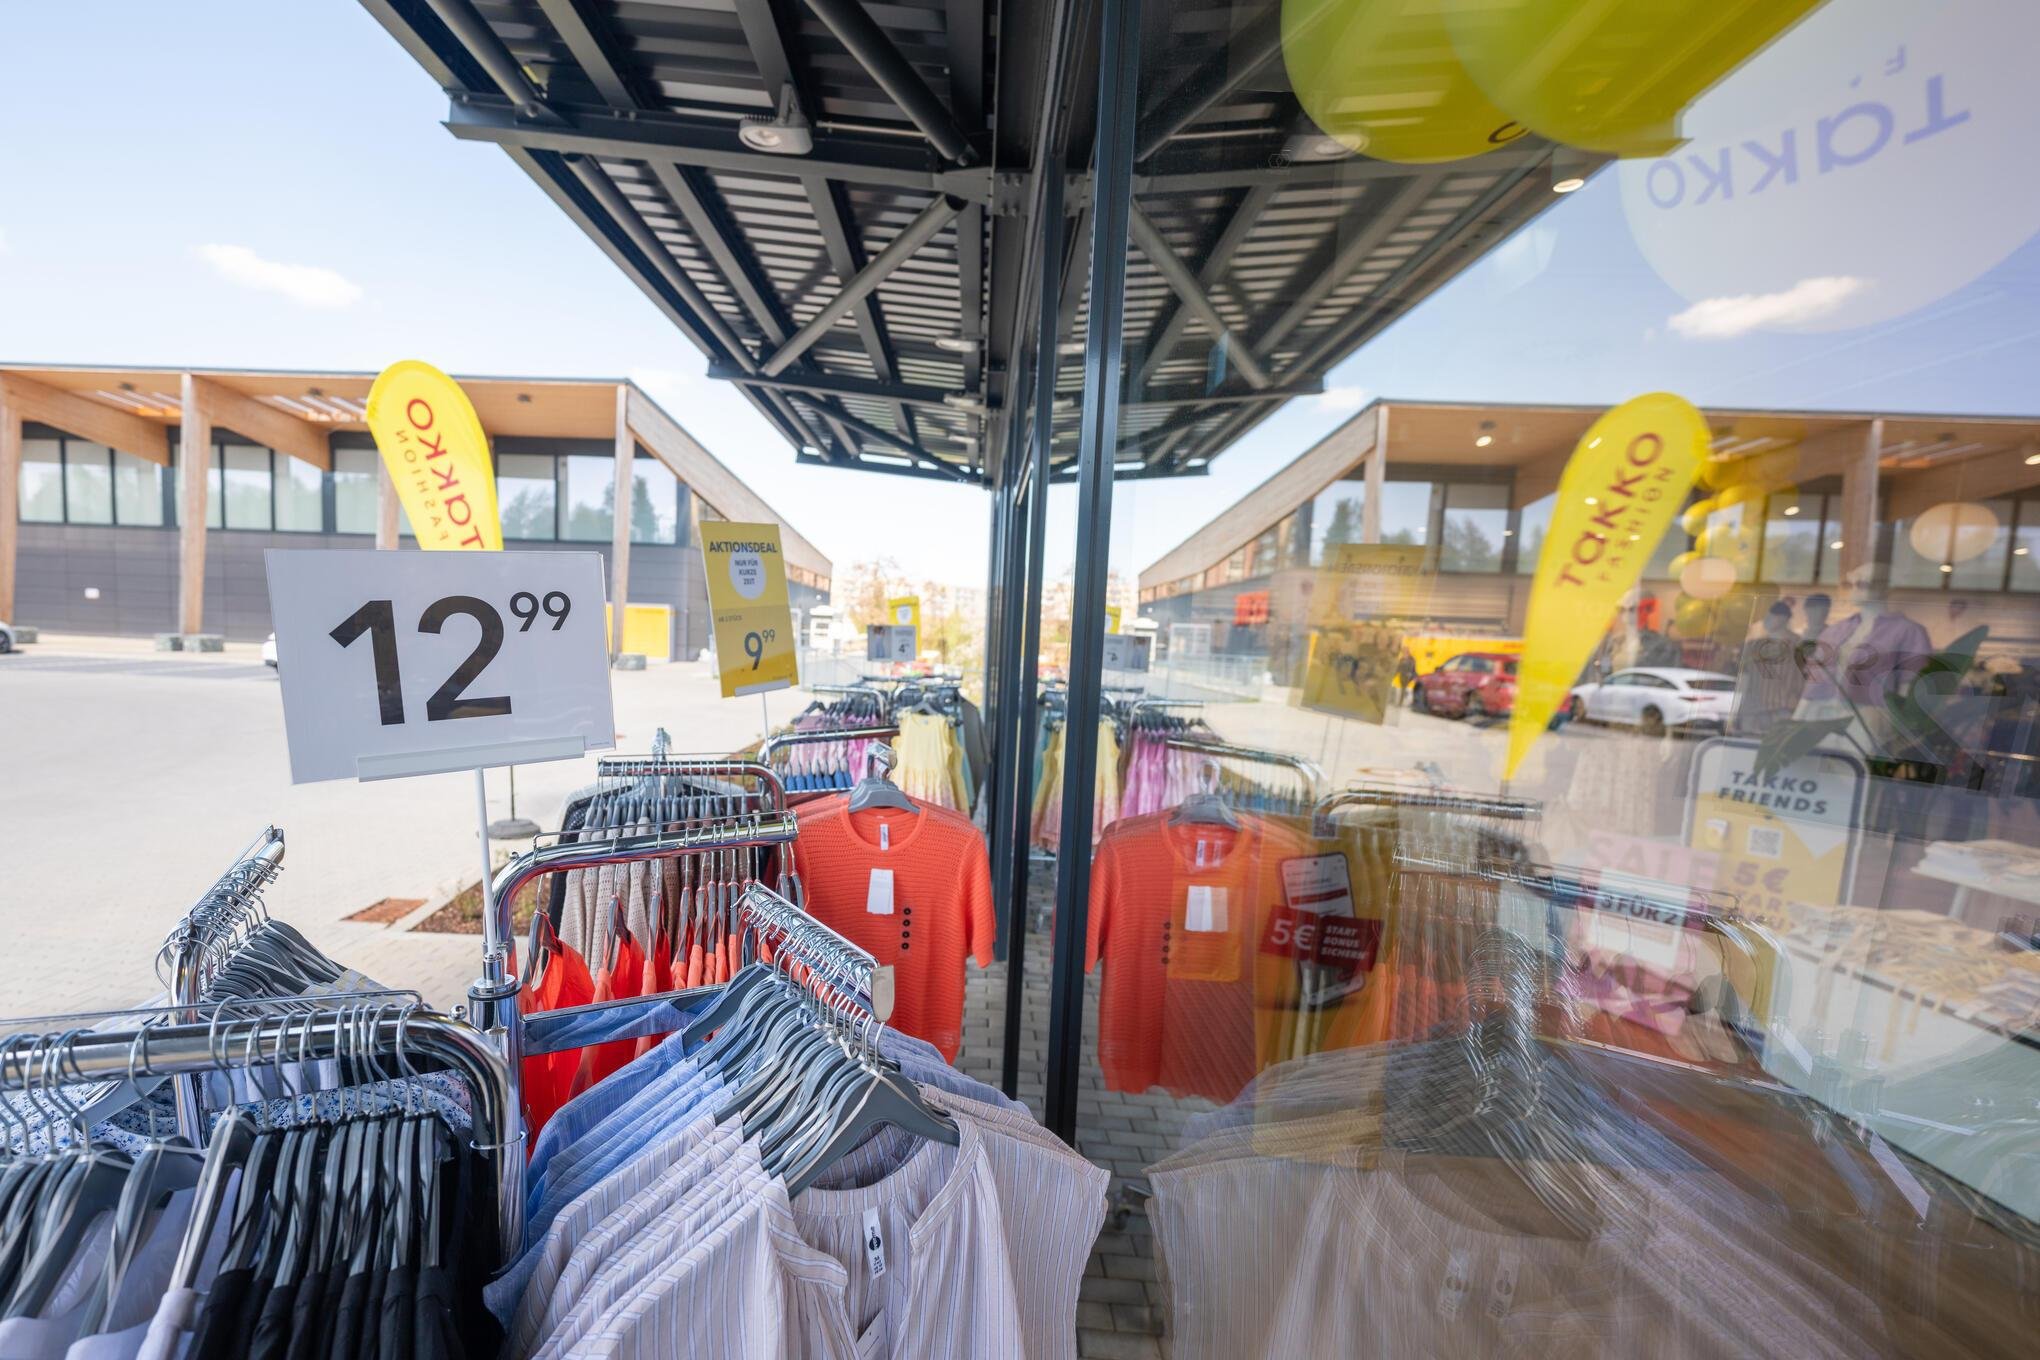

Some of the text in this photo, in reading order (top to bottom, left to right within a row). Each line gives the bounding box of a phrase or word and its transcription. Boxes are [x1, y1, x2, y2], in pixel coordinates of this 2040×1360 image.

[709, 541, 778, 553] AKTIONSDEAL
[1732, 770, 1818, 795] TAKKO
[1718, 786, 1828, 815] FRIENDS
[1325, 924, 1358, 937] START
[1322, 936, 1360, 949] BONUS
